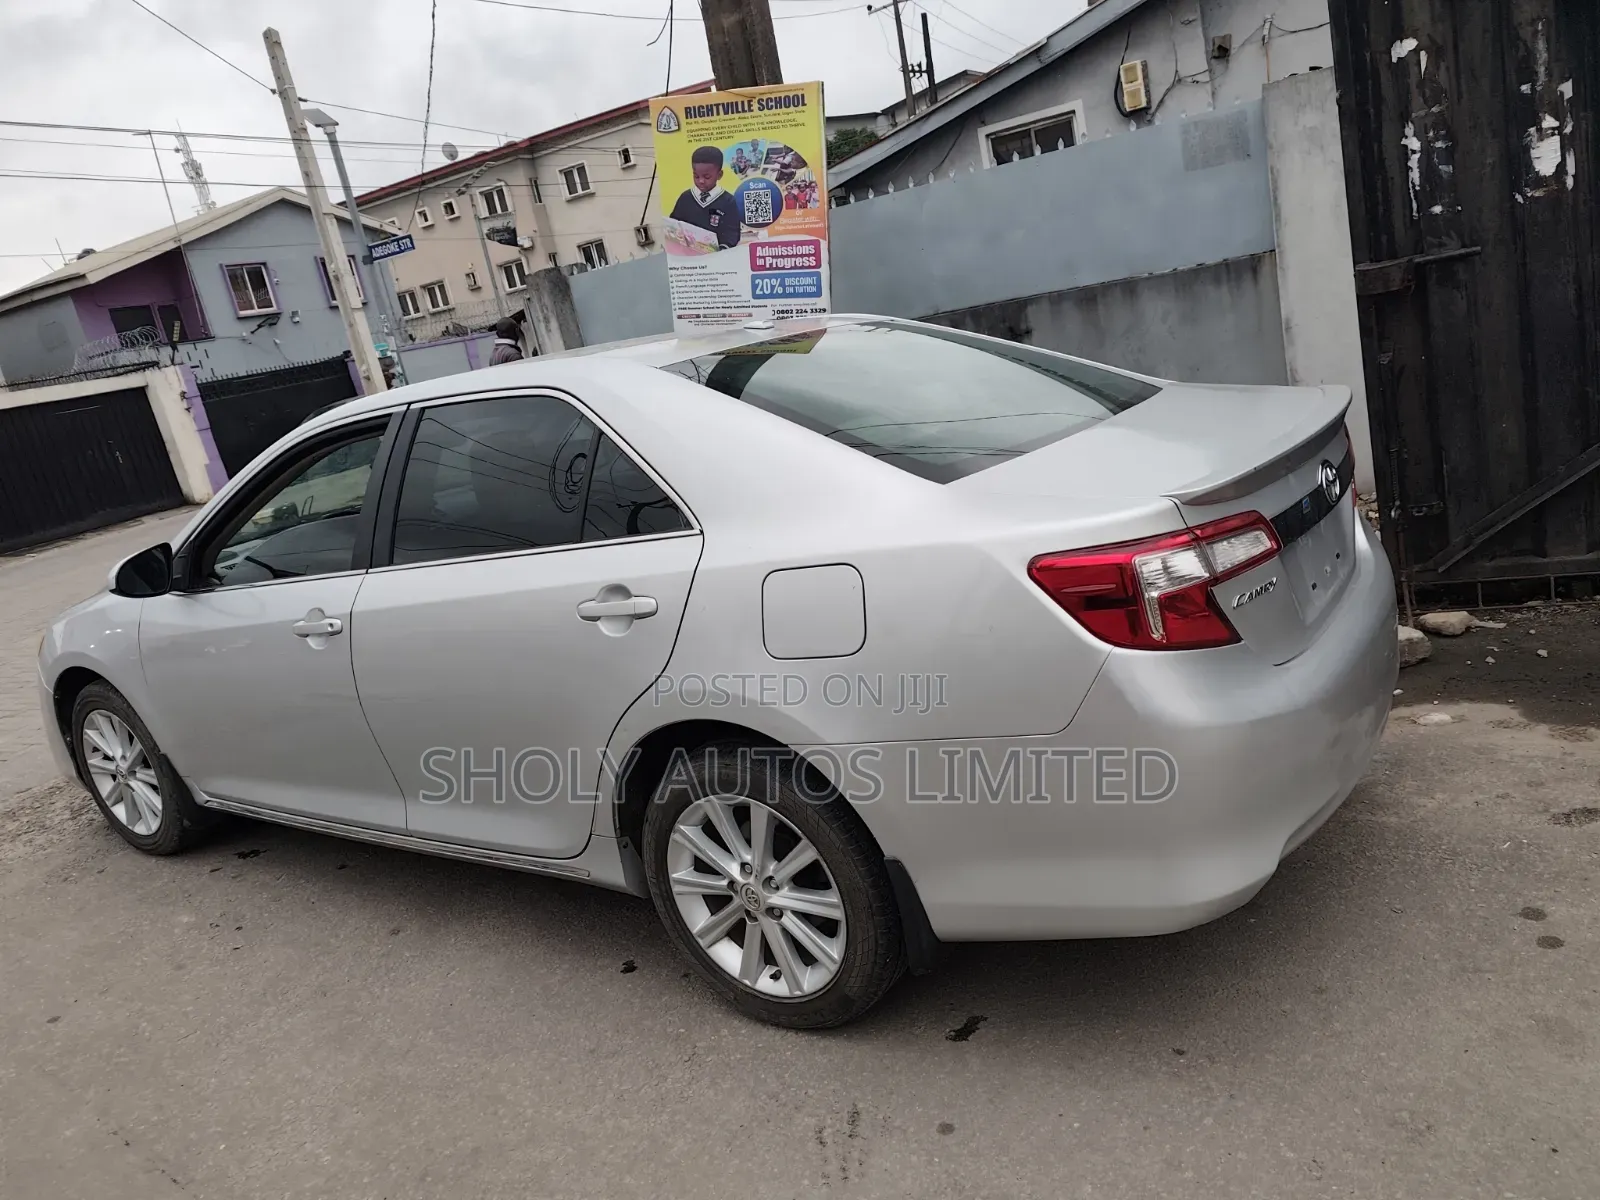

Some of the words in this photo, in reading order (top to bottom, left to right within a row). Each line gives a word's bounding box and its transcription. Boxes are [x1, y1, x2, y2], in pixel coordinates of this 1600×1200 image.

[684, 99, 754, 120] RIGHTVILLE
[757, 93, 807, 112] SCHOOL
[371, 242, 399, 258] ADEGOKE
[399, 238, 413, 250] STR
[756, 244, 816, 257] Admissions
[756, 257, 765, 266] in
[765, 256, 817, 269] Progress
[754, 277, 784, 295] 20%
[784, 276, 817, 286] DISCOUNT
[785, 286, 794, 294] ON
[795, 285, 817, 293] TUITION
[1232, 577, 1278, 609] CAMRY
